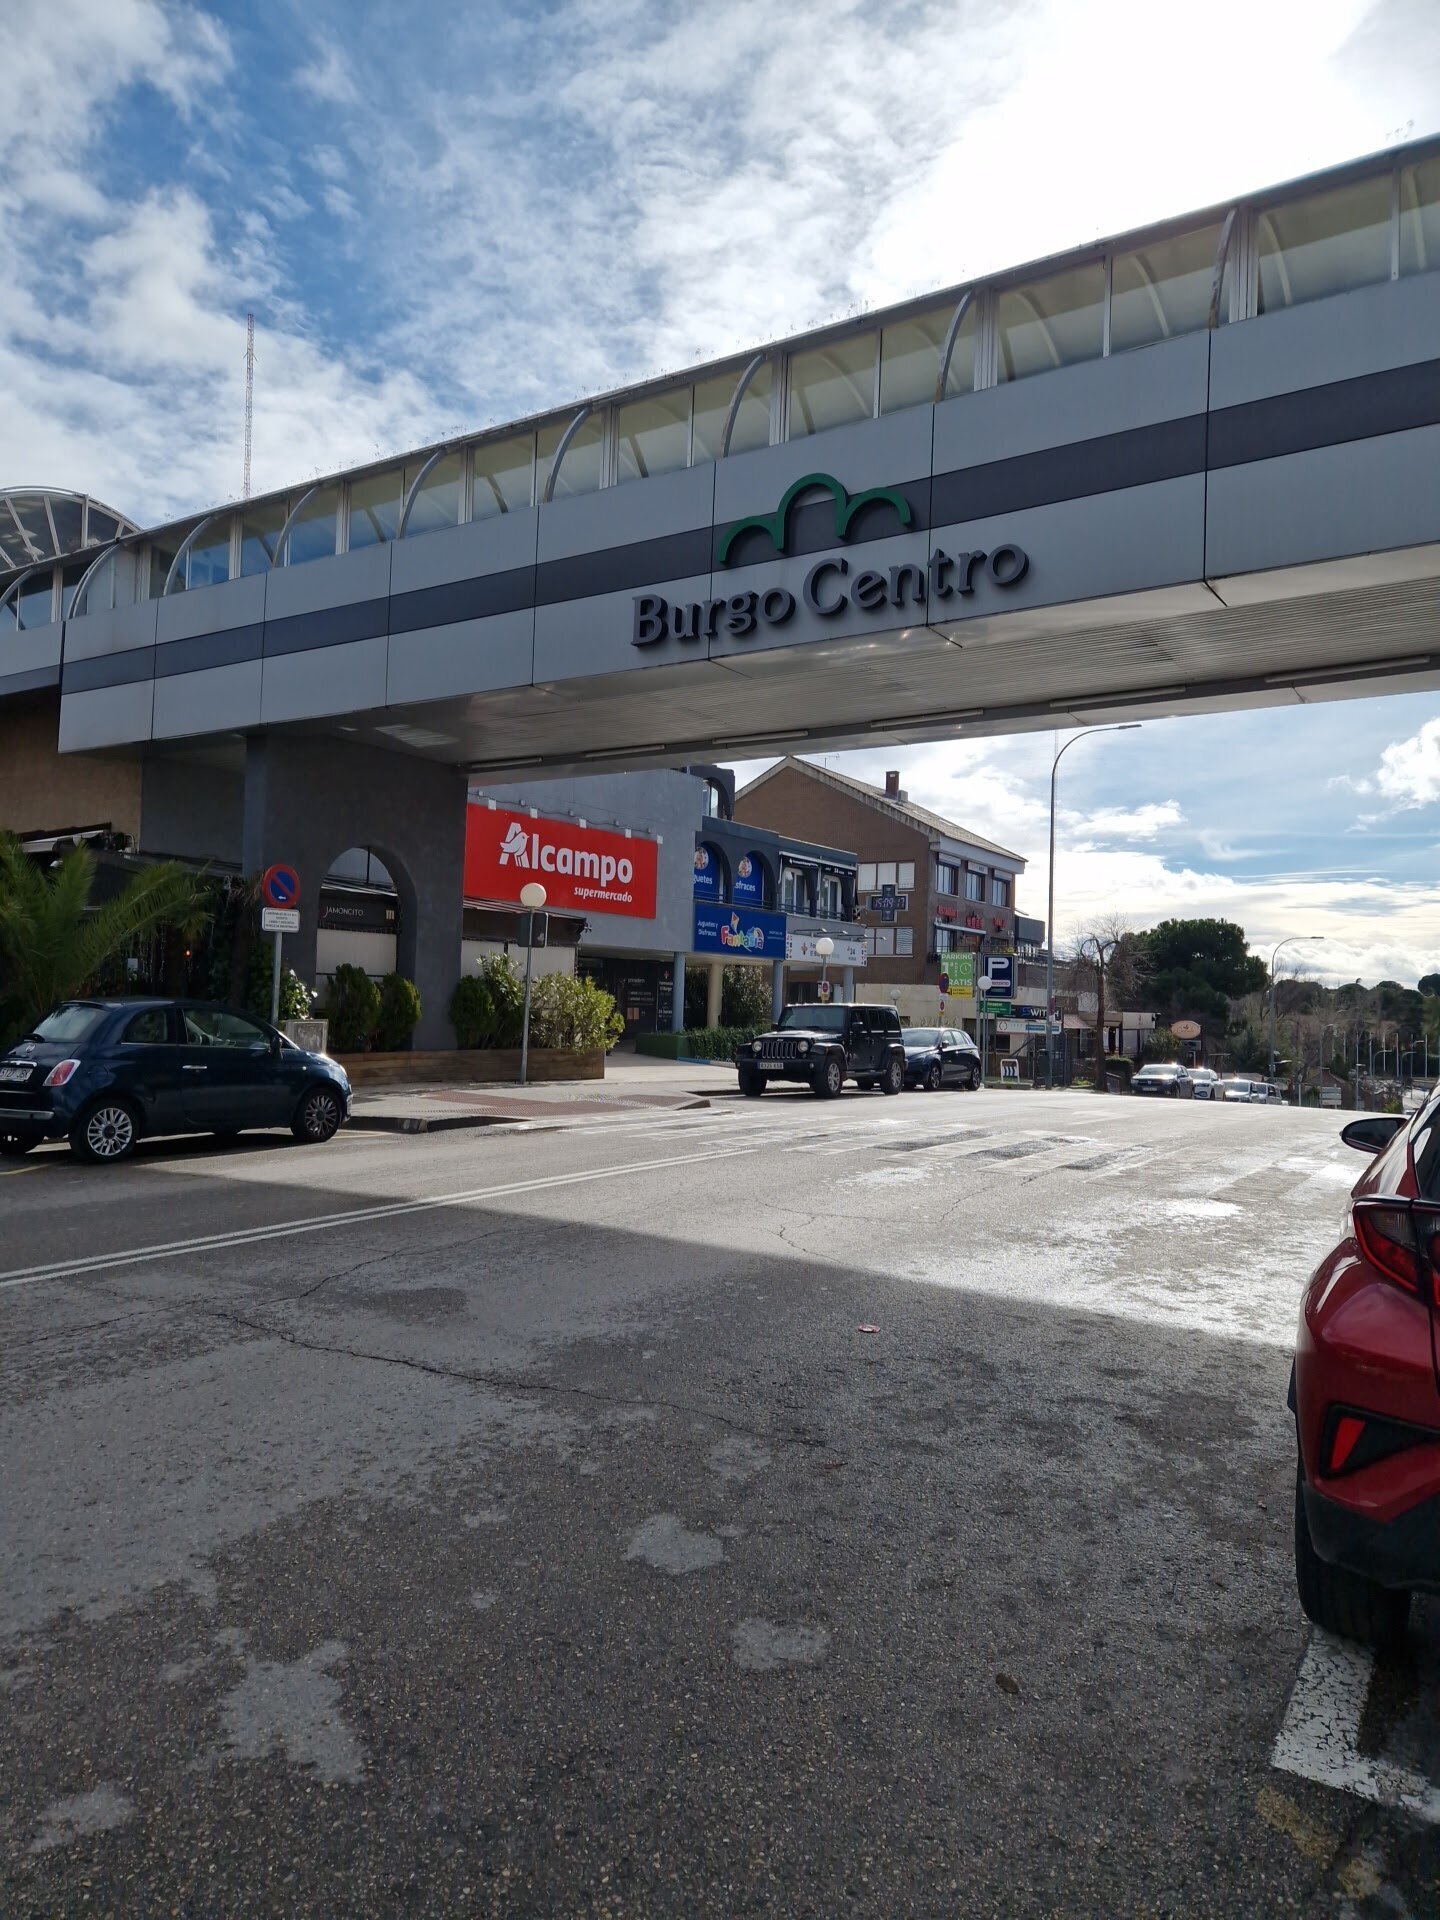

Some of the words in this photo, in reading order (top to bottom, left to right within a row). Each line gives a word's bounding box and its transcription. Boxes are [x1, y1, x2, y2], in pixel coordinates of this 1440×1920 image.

[631, 587, 795, 647] Burgo
[802, 543, 1029, 617] Centro
[499, 822, 633, 887] Alcampo
[574, 886, 633, 903] supermercado
[323, 905, 364, 918] JAMONCITO
[987, 957, 1009, 979] P
[1022, 1006, 1060, 1017] SWITH
